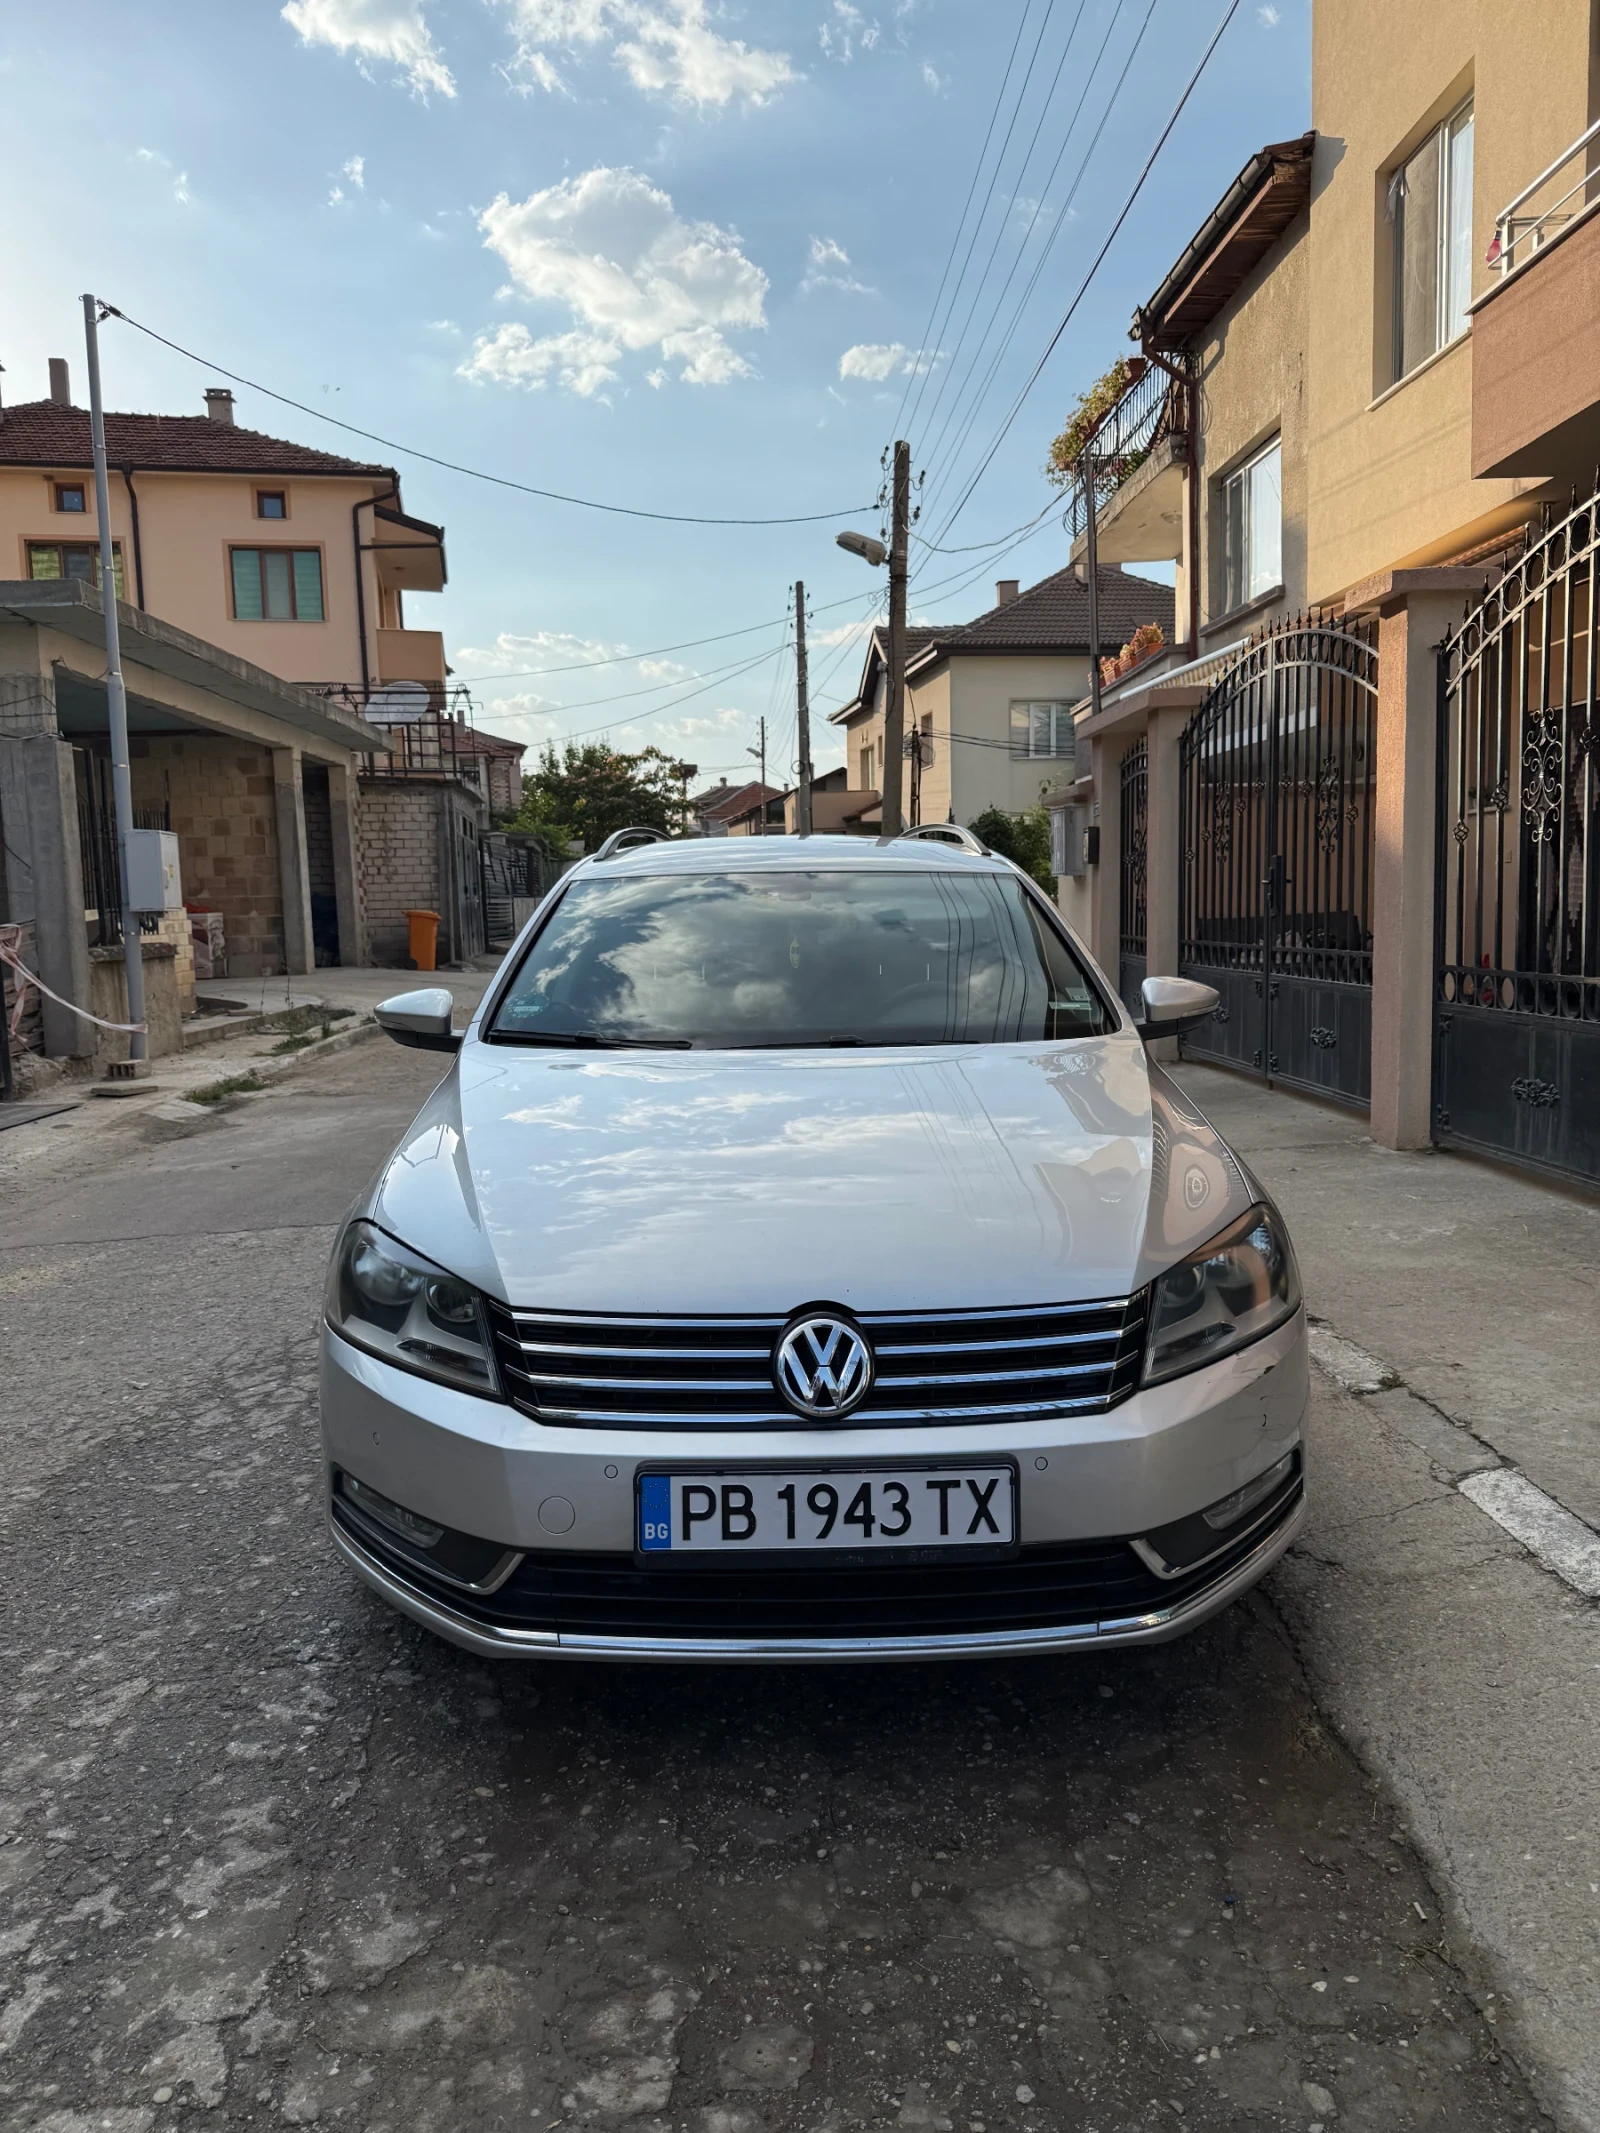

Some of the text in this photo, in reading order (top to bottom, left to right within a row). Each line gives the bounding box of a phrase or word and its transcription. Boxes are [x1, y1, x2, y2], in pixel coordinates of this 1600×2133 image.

[779, 1319, 869, 1410] VW
[644, 1522, 669, 1540] BG
[681, 1478, 1000, 1541] PB 1943 TX
